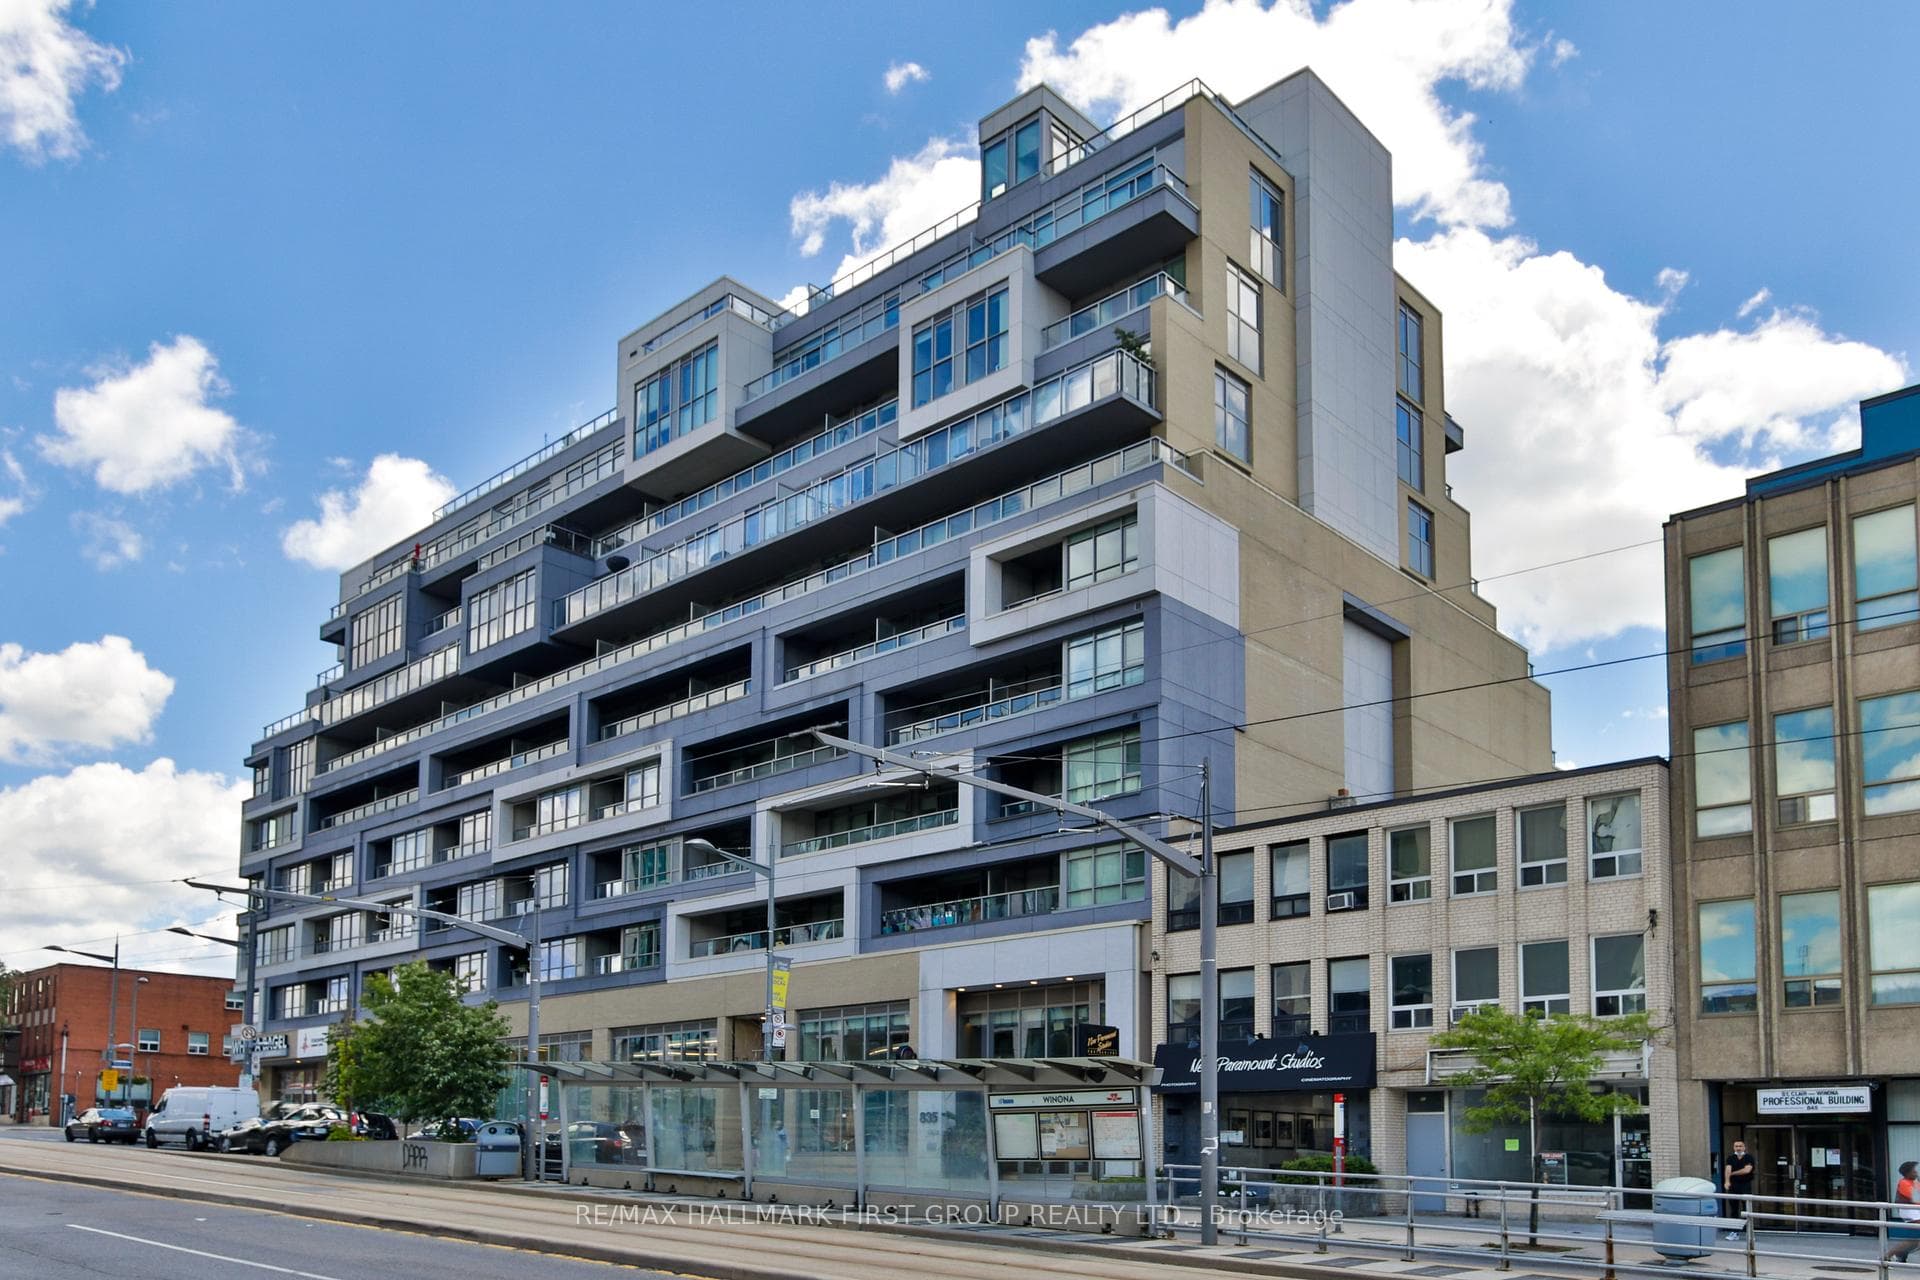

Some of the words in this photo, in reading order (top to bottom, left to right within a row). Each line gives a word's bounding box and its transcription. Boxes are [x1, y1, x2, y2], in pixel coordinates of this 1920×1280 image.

[1216, 1053, 1277, 1072] Paramount
[1277, 1050, 1325, 1071] Studios
[1042, 1095, 1074, 1104] WINONA
[1763, 1097, 1824, 1106] PROFESSIONAL
[1828, 1095, 1865, 1104] BUILDING
[920, 1111, 938, 1123] 835
